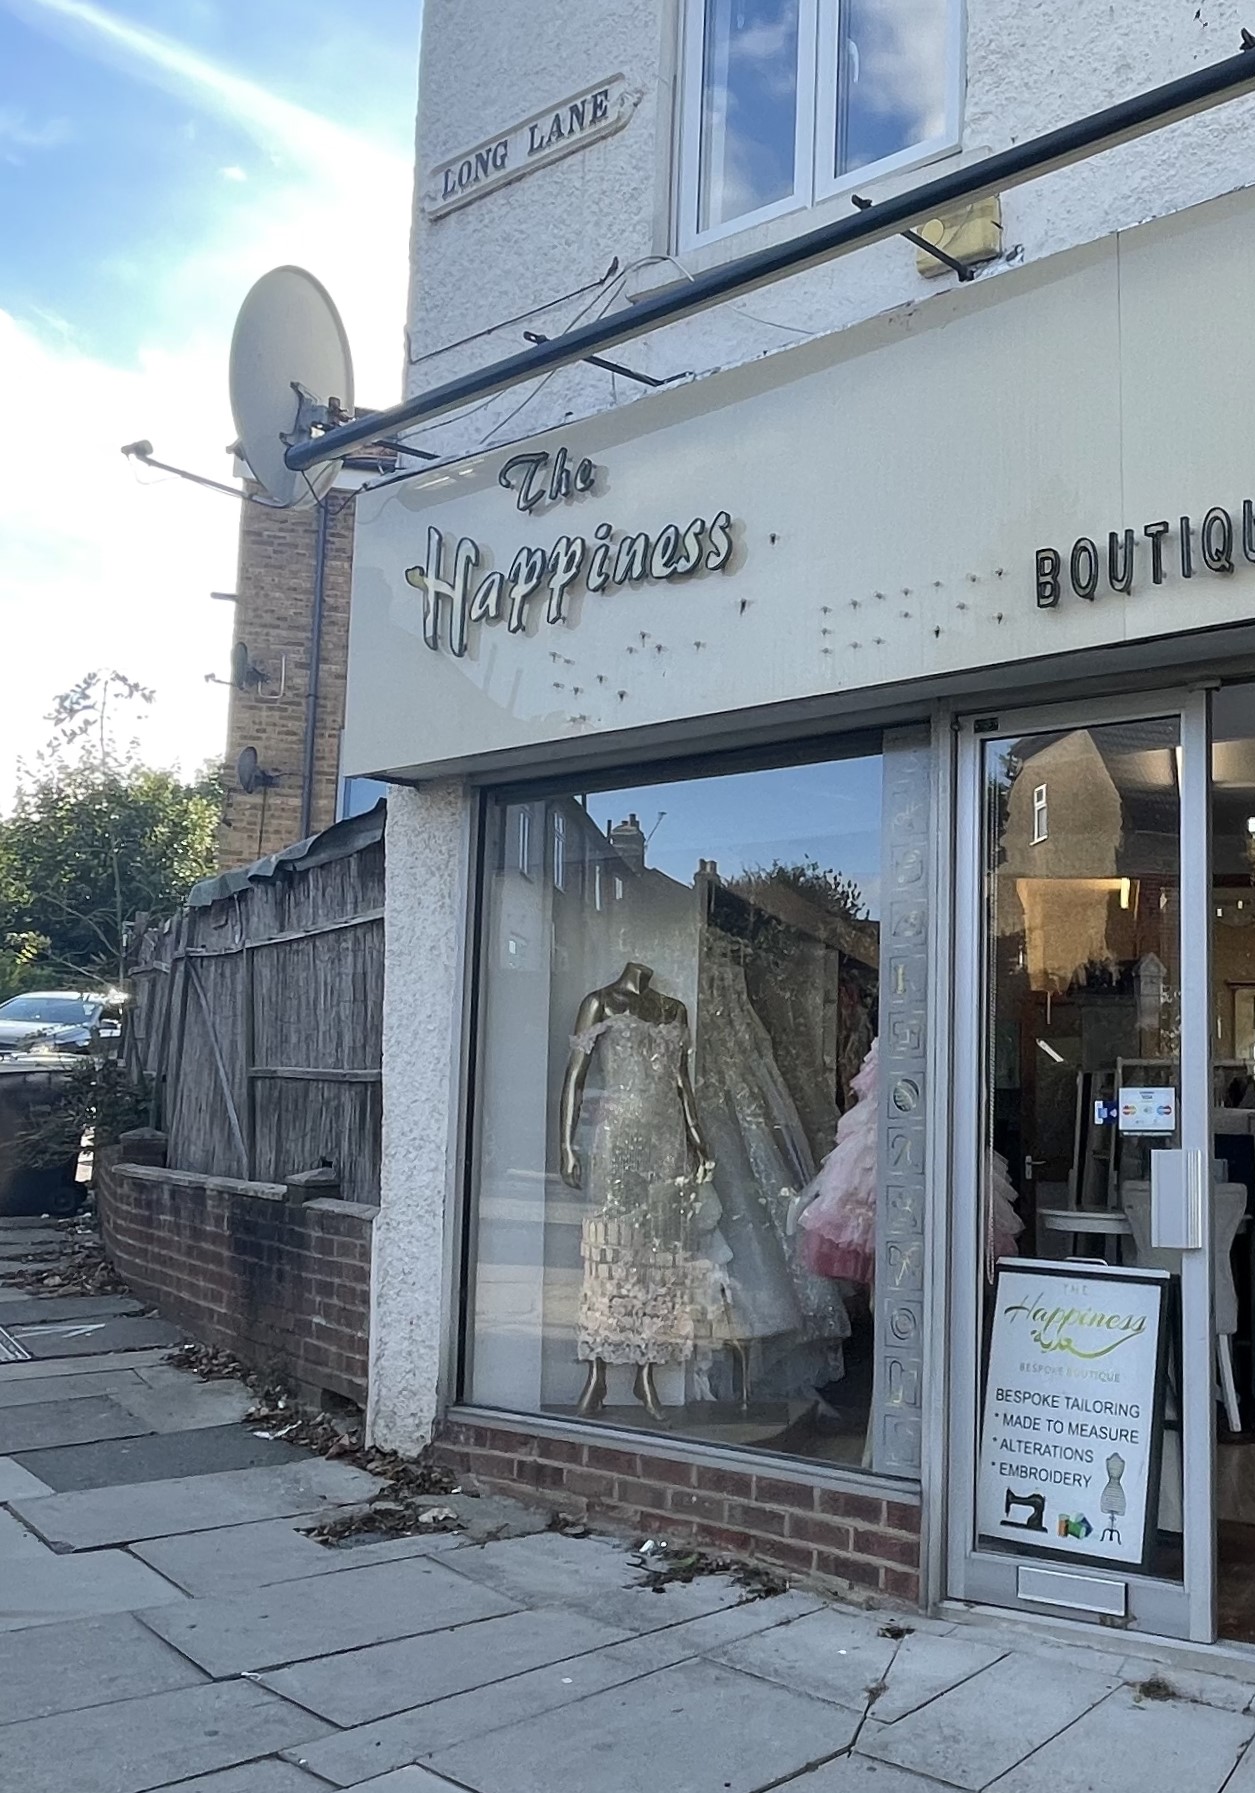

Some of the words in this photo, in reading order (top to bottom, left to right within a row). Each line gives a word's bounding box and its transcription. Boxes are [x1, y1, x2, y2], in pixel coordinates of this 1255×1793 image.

[441, 139, 509, 201] LONG
[527, 88, 610, 157] LANE
[499, 447, 595, 512] The
[405, 510, 731, 657] Happiness
[1063, 1284, 1089, 1296] THE
[1003, 1291, 1147, 1335] Happiness
[1019, 1361, 1063, 1378] BESPOKE
[1066, 1367, 1121, 1384] BOUTIQUE
[996, 1387, 1060, 1409] BESPOKE
[1065, 1396, 1141, 1419] TAILORING
[1003, 1412, 1041, 1432] MADE
[1046, 1418, 1064, 1434] TO
[1067, 1423, 1140, 1445] MEASURE
[999, 1438, 1095, 1463] ALTERATIONS
[999, 1462, 1093, 1488] EMBROIDERY
